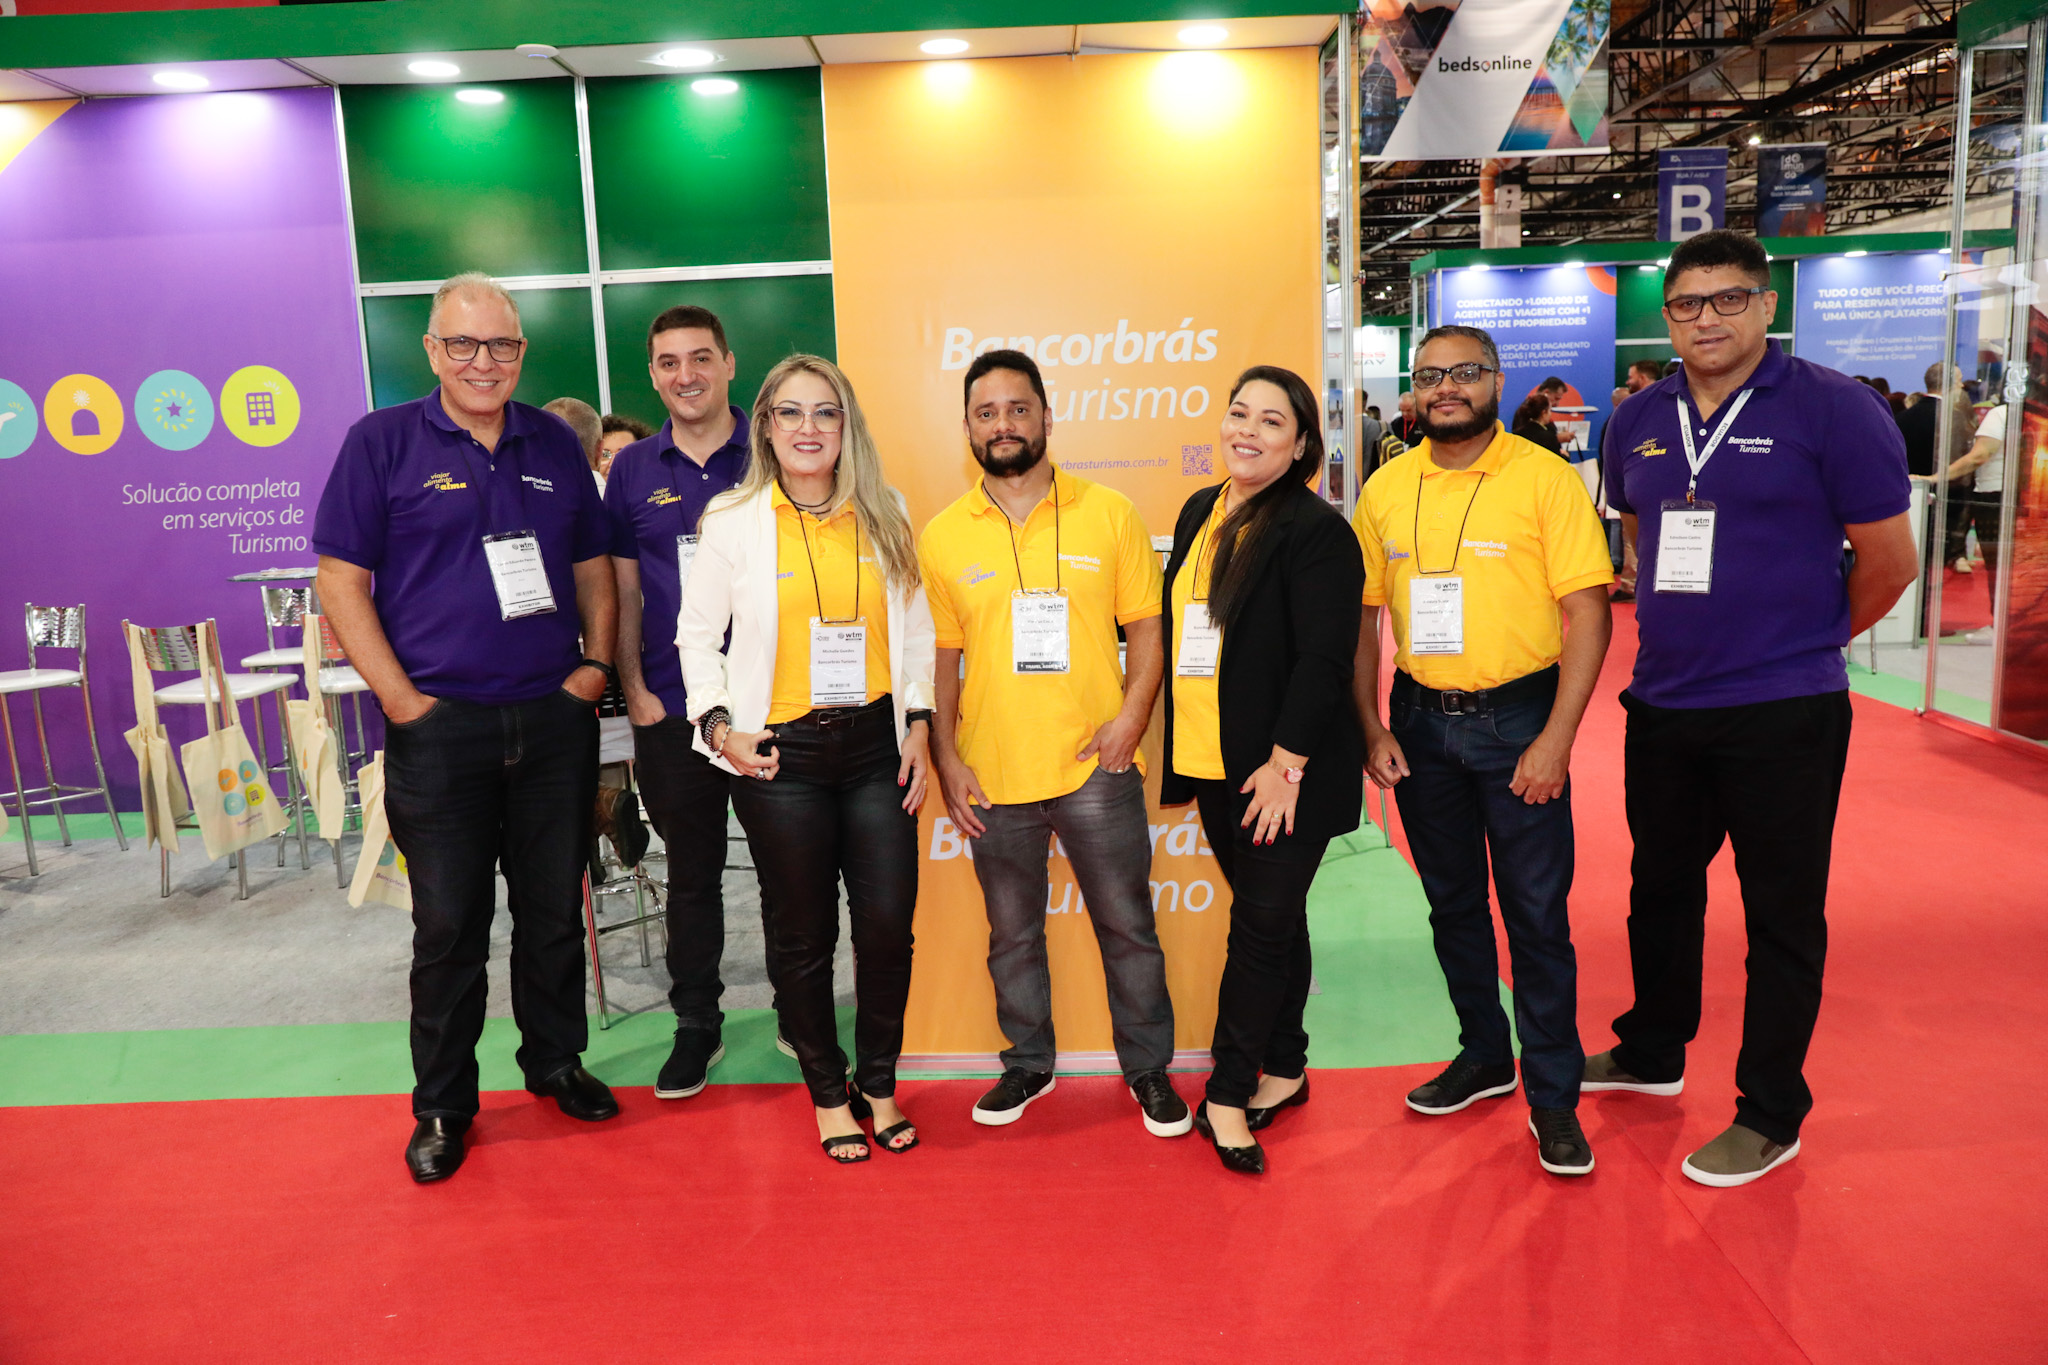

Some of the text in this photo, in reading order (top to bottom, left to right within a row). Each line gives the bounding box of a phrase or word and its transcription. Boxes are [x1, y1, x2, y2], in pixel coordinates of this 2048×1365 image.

[1438, 55, 1532, 73] bedsonline
[1506, 200, 1512, 209] 7
[1670, 185, 1714, 242] B
[1818, 288, 1848, 298] TUDO
[1849, 287, 1859, 297] O
[1860, 287, 1883, 297] QUE
[1885, 283, 1914, 295] VOCÊ
[1456, 298, 1523, 308] CONECTANDO
[1574, 295, 1589, 304] DE
[1813, 300, 1842, 310] PARA
[1844, 298, 1898, 309] RESERVAR
[1900, 295, 1945, 306] VIAGENS
[1454, 306, 1591, 319] AGENTES DE VIAGENS COM +1
[1822, 308, 1947, 321] UMA ÚNICA PLATAFORM
[1458, 317, 1587, 328] MILHÃO DE PROPRIEDADES
[1502, 343, 1530, 352] OPÇÃO
[1530, 342, 1541, 350] DE
[1543, 341, 1591, 350] PAGAMENTO
[1499, 352, 1524, 360] OEDAS
[1528, 350, 1579, 359] PLATAFORMA
[1518, 360, 1530, 368] EM
[1540, 359, 1572, 367] IDIOMAS
[1042, 378, 1210, 423] urismo
[1683, 424, 1692, 447] ECUADOR
[1711, 422, 1729, 448] ECUADOR
[1728, 436, 1774, 446] Bancorbrás
[1644, 448, 1667, 457] alma
[1739, 444, 1771, 454] Turismo
[430, 472, 450, 480] viajar
[423, 477, 453, 488] alimenta
[440, 482, 467, 491] alma
[206, 477, 301, 504] completa
[653, 487, 670, 496] viajar
[162, 504, 305, 532] em serviços de
[228, 533, 308, 554] Turismo
[1463, 539, 1508, 550] Bancorbrás
[1058, 552, 1101, 566] Bancorbrás
[1474, 548, 1506, 558] Turismo
[1070, 561, 1100, 573] Turismo
[971, 571, 996, 585] alma
